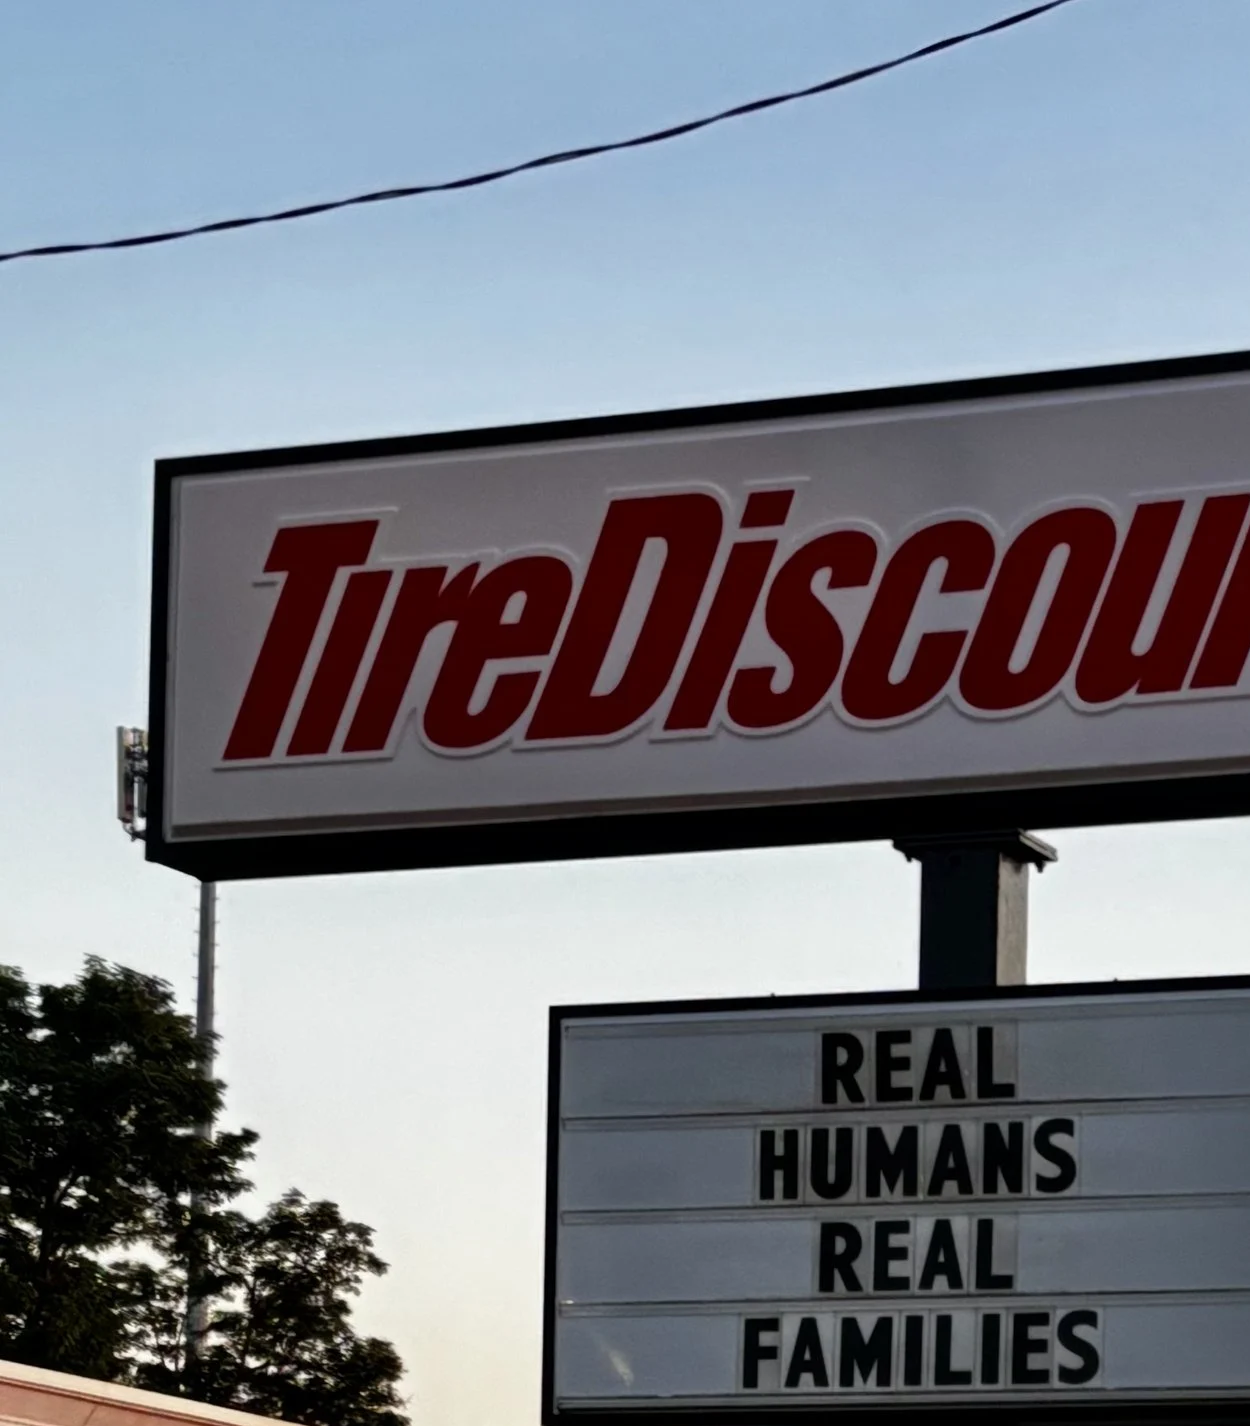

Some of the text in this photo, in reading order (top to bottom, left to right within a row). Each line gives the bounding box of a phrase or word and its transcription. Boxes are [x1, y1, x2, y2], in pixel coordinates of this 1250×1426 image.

[820, 1026, 1016, 1105] REAL
[758, 1118, 1077, 1201] HUMANS
[818, 1218, 1014, 1293] REAL
[742, 1309, 1101, 1389] FAMILIES
